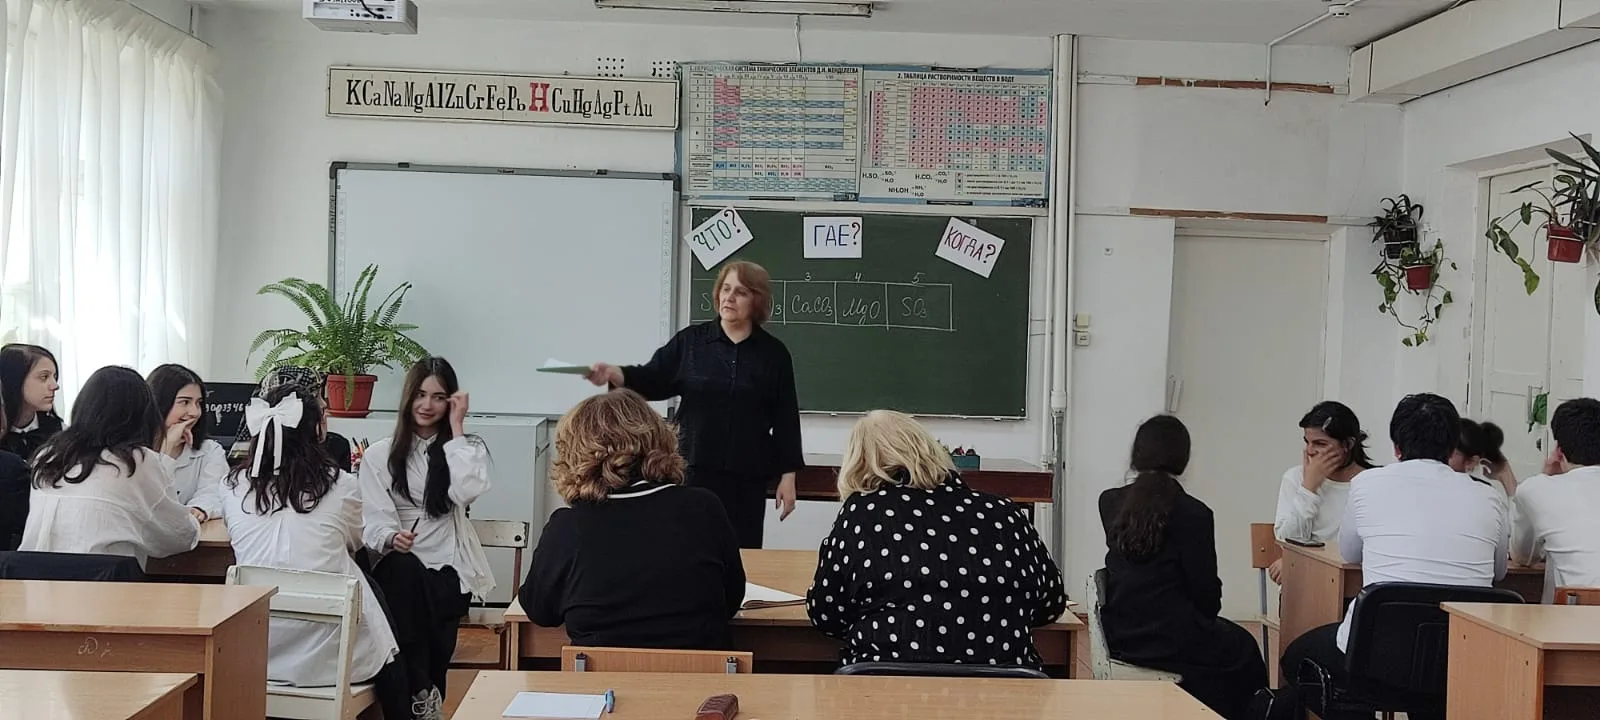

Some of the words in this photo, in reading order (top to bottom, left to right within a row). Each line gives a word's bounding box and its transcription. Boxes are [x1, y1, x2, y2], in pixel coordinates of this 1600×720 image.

[928, 74, 971, 82] РАСТВОРИМОСТИ
[528, 82, 550, 112] H
[693, 209, 741, 251] ЧТО?
[944, 226, 997, 264] КОГДА?
[804, 272, 811, 281] 3
[911, 272, 926, 285] 5
[842, 297, 881, 326] MgO
